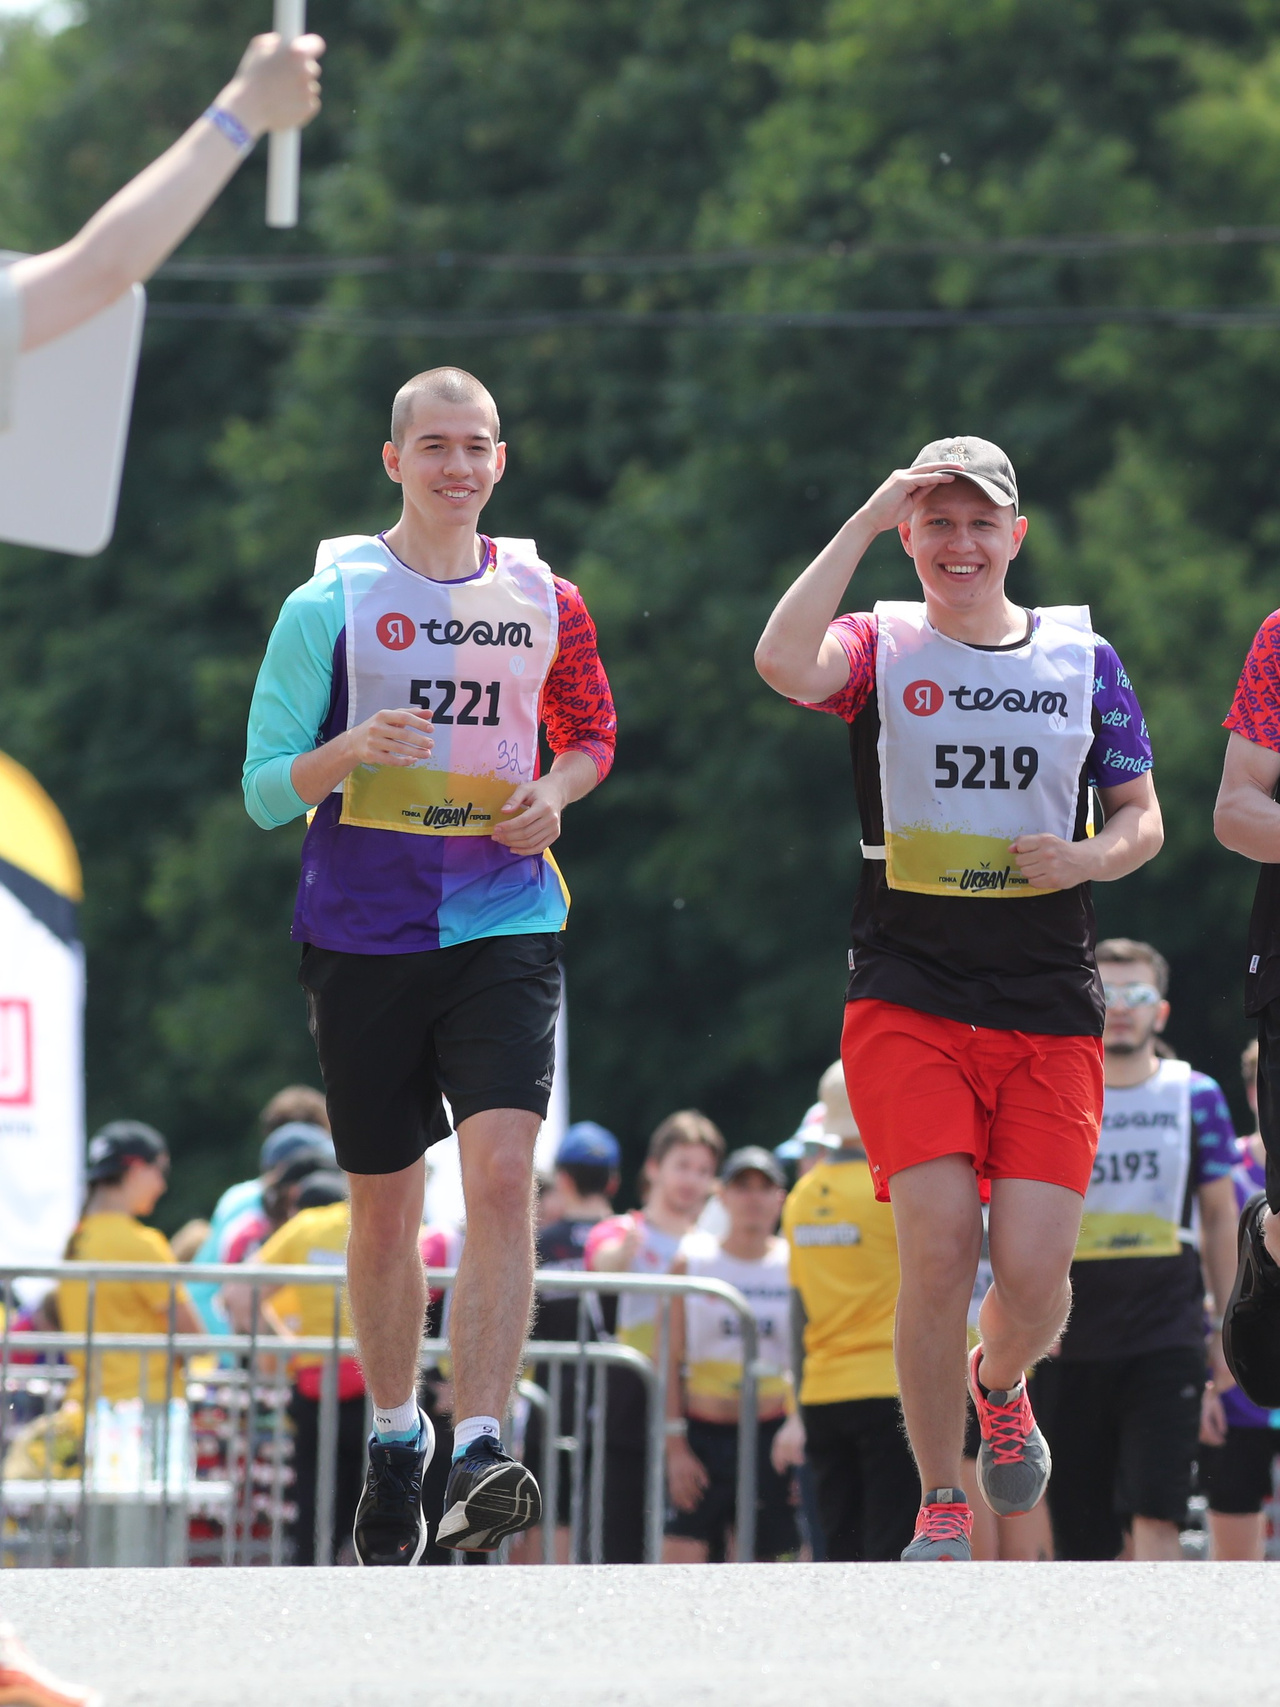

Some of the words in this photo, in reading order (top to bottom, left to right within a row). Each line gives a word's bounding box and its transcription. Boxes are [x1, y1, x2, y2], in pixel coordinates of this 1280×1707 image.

[420, 617, 534, 649] team
[558, 610, 587, 636] ndex
[409, 679, 501, 726] 5221
[948, 685, 1069, 719] team
[1102, 707, 1132, 729] dex
[934, 744, 1039, 791] 5219
[1102, 747, 1154, 774] Yande
[401, 809, 421, 819] ГОНКА
[423, 802, 473, 829] URBAN
[959, 865, 1011, 893] URBAN
